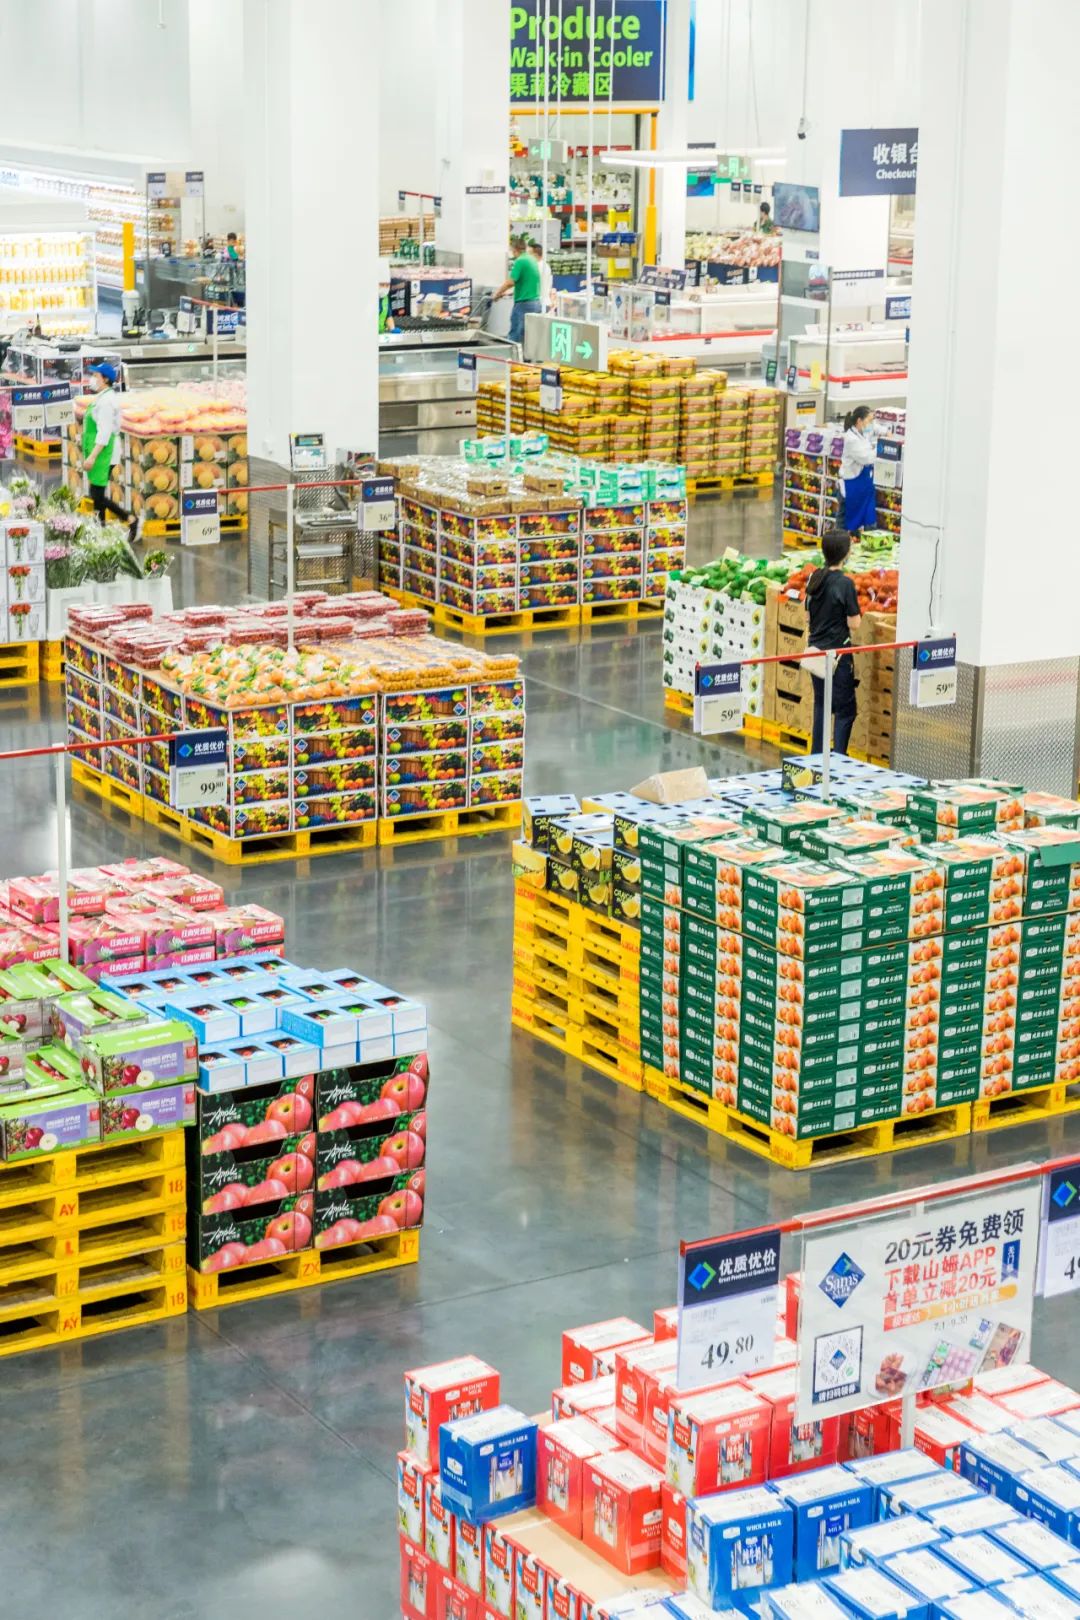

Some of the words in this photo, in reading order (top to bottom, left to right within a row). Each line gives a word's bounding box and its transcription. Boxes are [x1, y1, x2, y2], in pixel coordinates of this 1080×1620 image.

[510, 6, 641, 41] Produce
[510, 46, 583, 68] Walk-in
[588, 45, 654, 68] Cooler
[510, 71, 613, 98] 果蔬冷藏区
[194, 740, 225, 752] 优质优价
[884, 1207, 1025, 1265] 20元券免费领
[719, 1247, 777, 1277] 优质优价
[884, 1246, 996, 1291] 下载山姆APP
[829, 1501, 847, 1511] WHOLE
[847, 1497, 861, 1506] MILK
[746, 1523, 767, 1532] WHOLE
[767, 1519, 782, 1528] MILK
